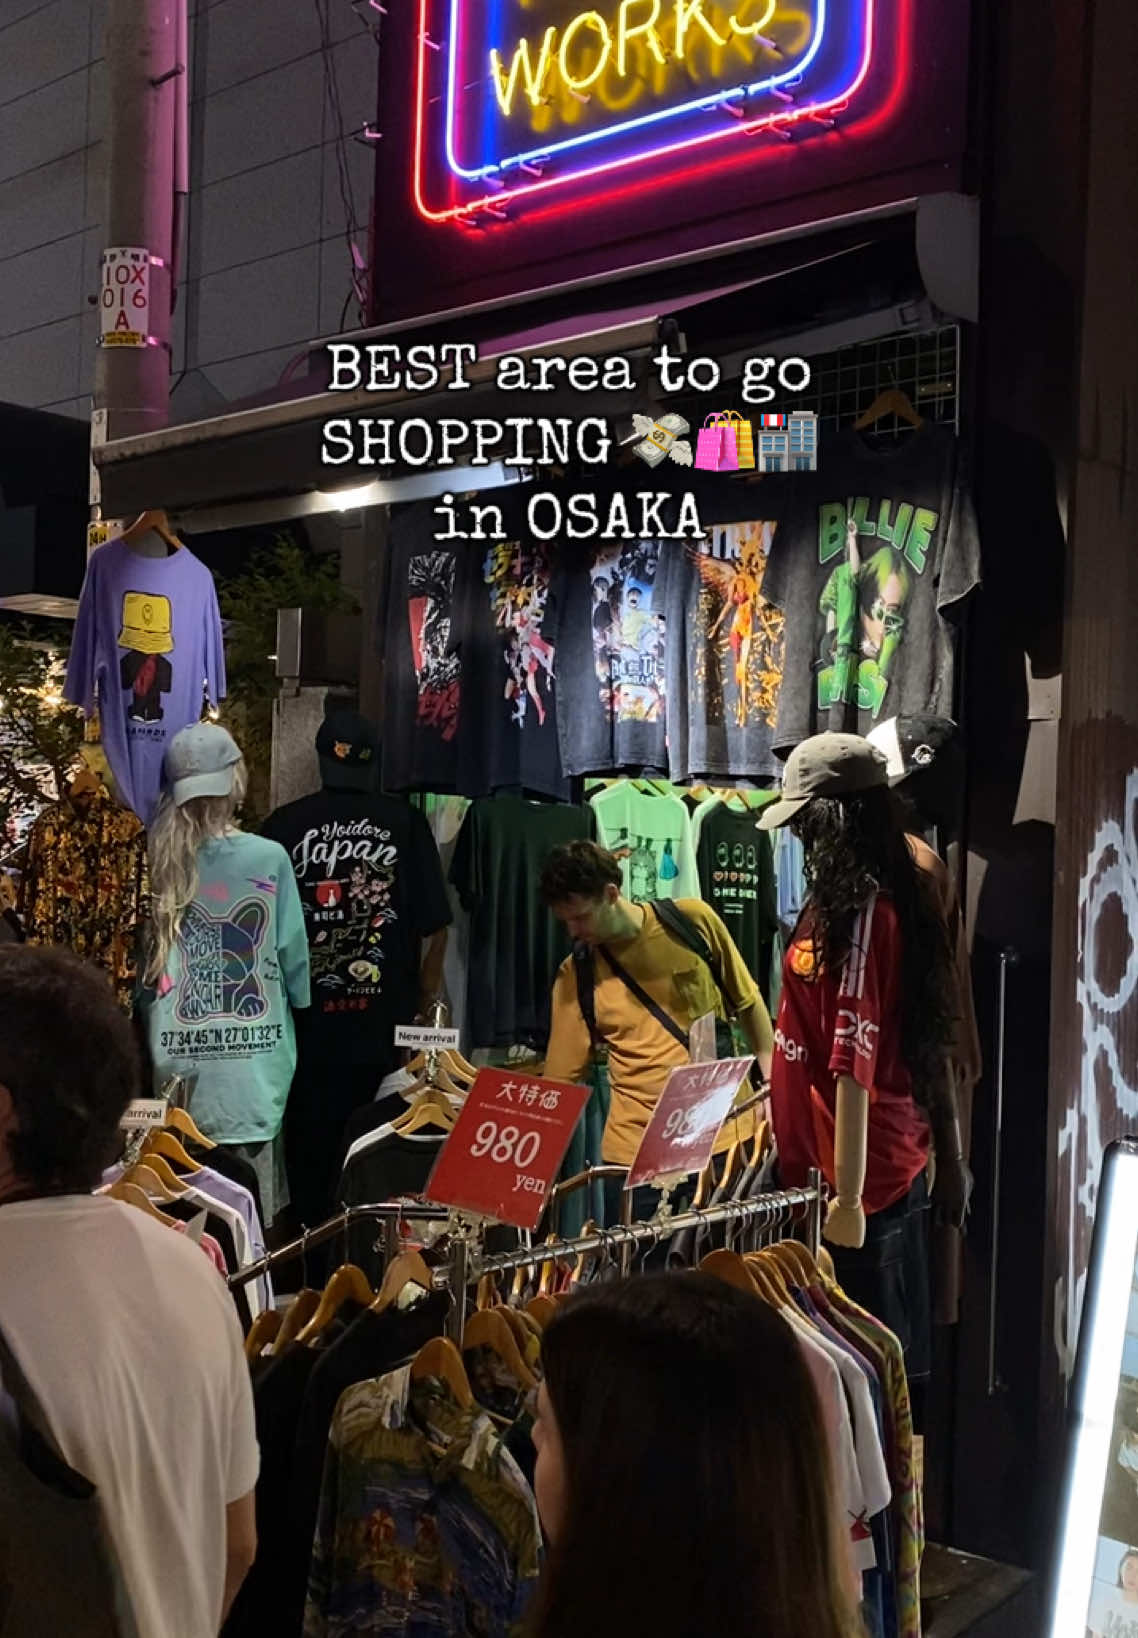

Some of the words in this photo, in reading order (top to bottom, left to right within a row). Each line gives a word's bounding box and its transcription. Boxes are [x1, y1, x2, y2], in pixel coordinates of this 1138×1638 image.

[114, 309, 130, 330] A
[320, 818, 391, 842] Yoidore
[292, 828, 400, 878] Japan
[227, 1041, 277, 1051] MOVEMENT
[398, 1031, 421, 1041] New
[423, 1033, 456, 1044] arrival
[495, 1081, 561, 1110] 大特価
[470, 1121, 541, 1169] 980
[511, 1173, 546, 1194] yen
